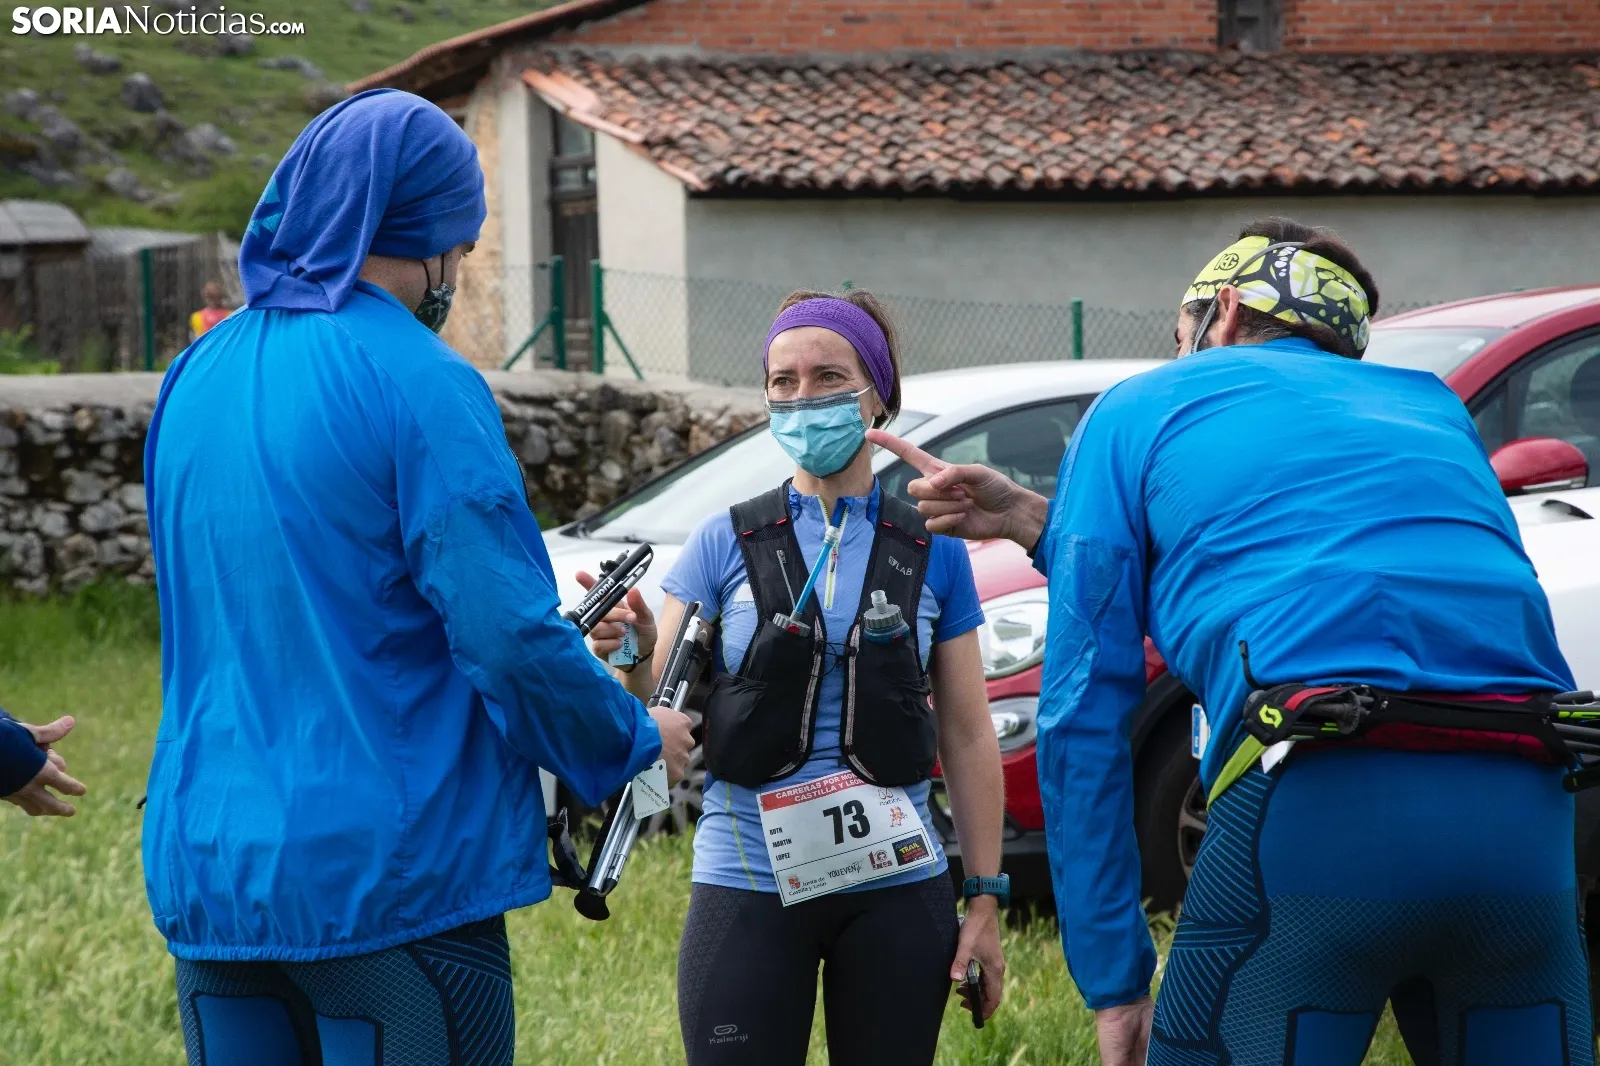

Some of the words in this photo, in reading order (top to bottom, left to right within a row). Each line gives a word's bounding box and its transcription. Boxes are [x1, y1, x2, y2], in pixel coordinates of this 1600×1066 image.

[575, 577, 615, 616] Diamond
[775, 781, 821, 799] CARRERAS
[823, 776, 840, 787] POR
[841, 772, 858, 781] MON
[794, 785, 837, 802] CASTILLA
[822, 799, 871, 846] 73
[899, 842, 920, 854] TRAIL
